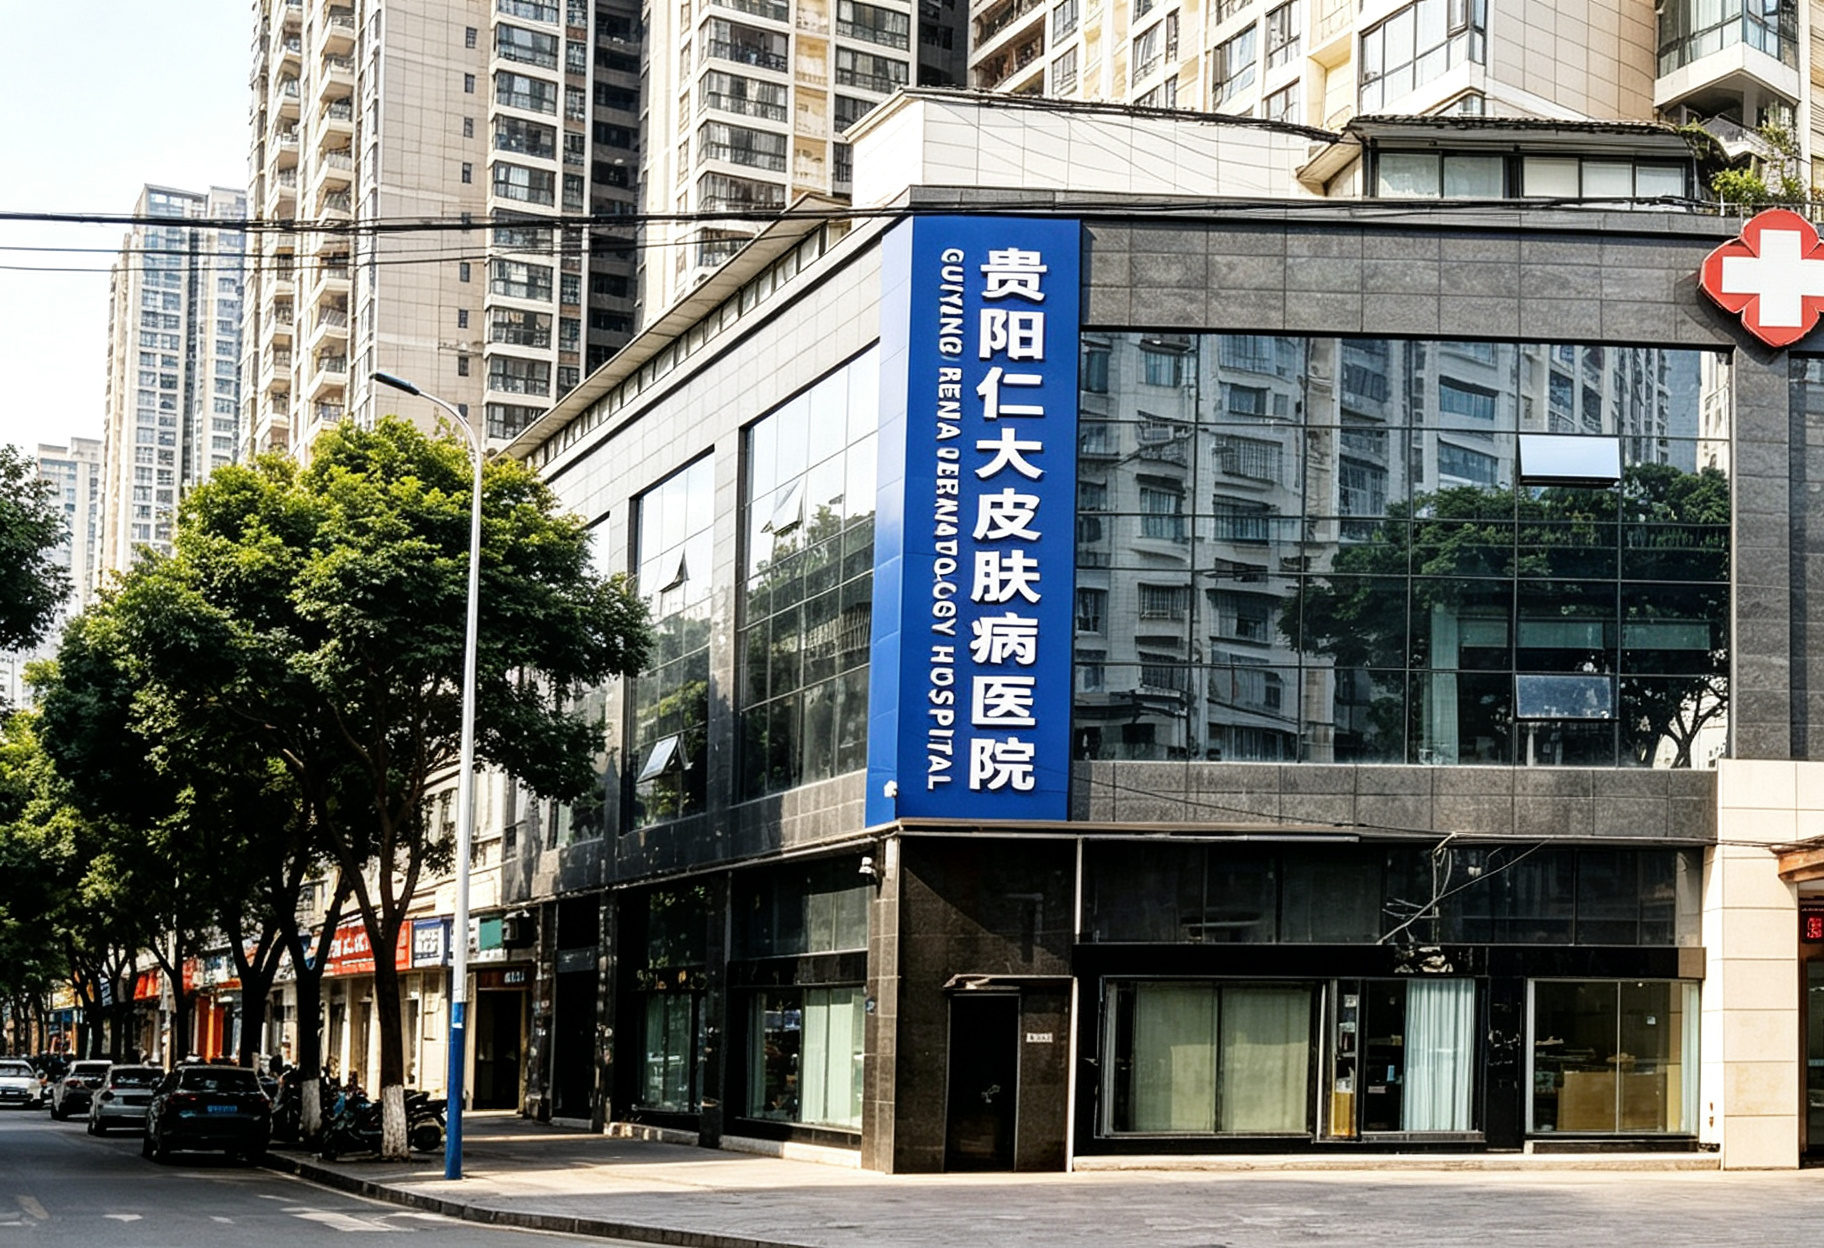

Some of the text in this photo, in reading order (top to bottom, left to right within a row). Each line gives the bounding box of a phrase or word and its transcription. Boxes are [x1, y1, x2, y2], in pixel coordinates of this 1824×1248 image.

[969, 247, 1048, 791] 贵阳仁大皮肤病医院
[926, 645, 955, 791] HOSPITAL
